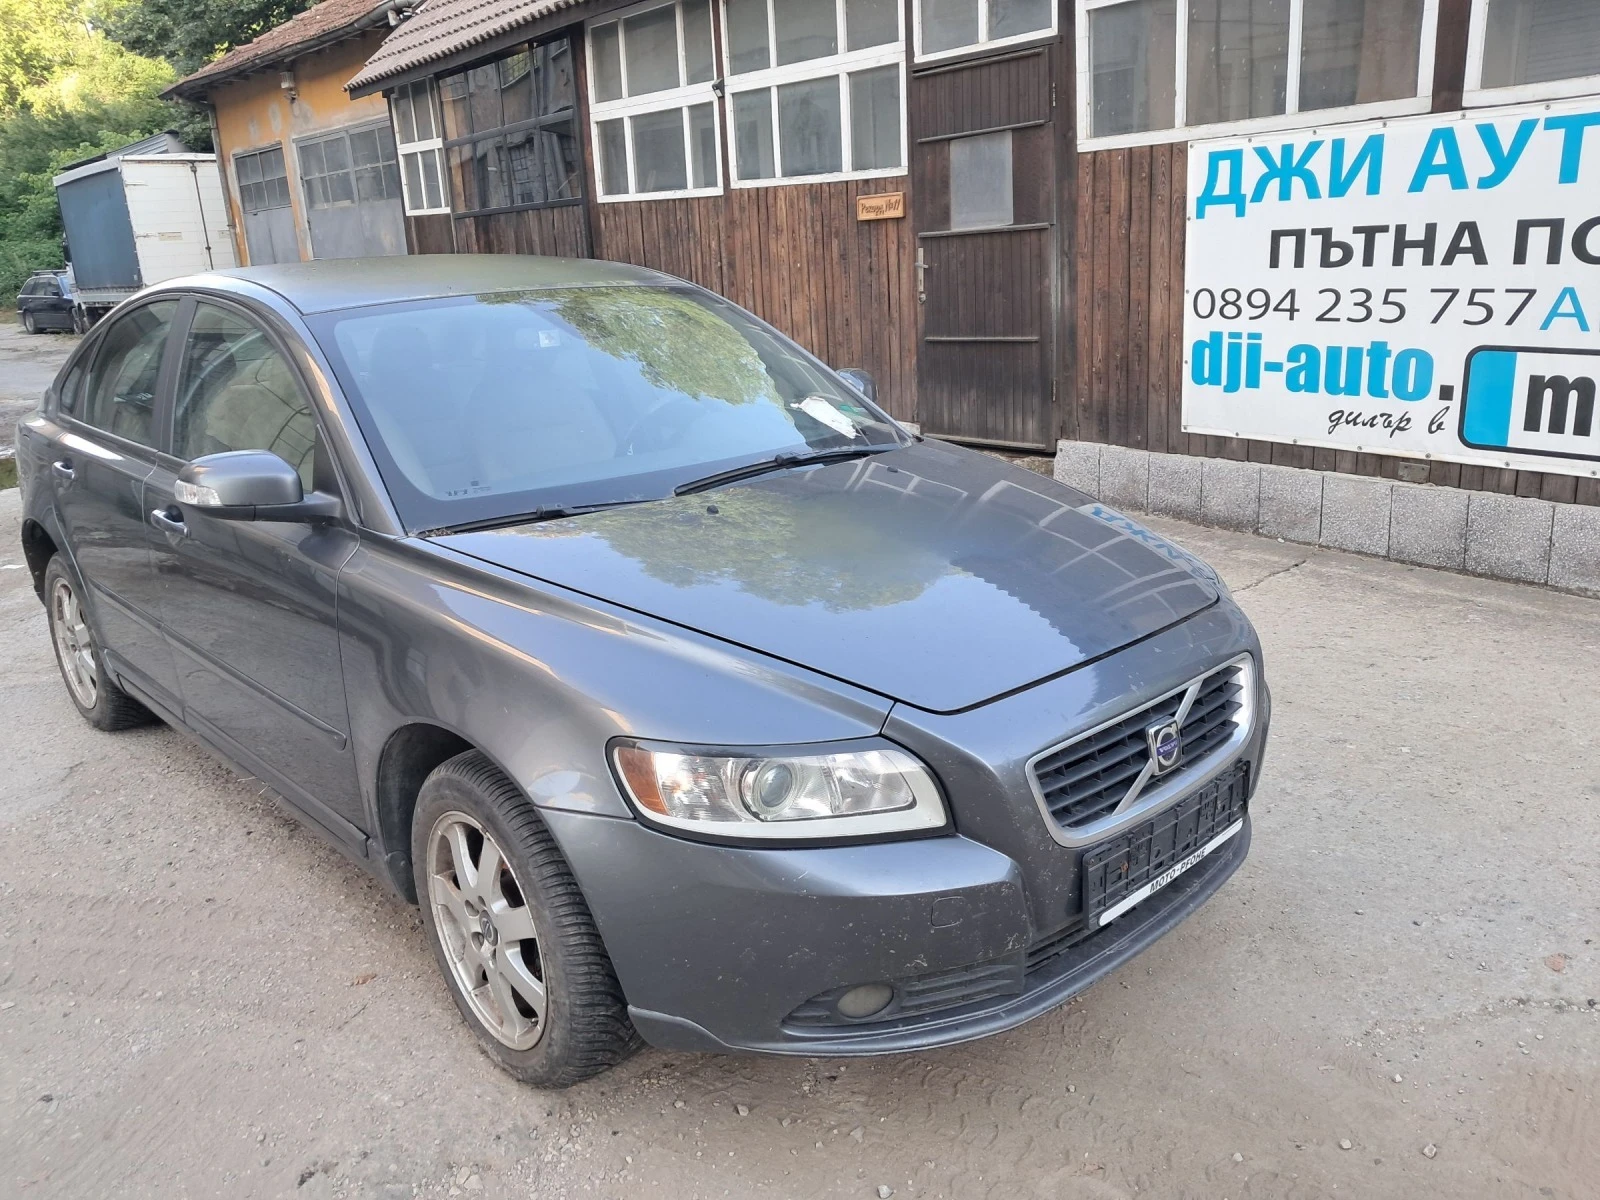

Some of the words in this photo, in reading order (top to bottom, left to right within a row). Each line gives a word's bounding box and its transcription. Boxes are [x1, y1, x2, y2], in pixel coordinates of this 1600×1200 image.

[1196, 134, 1384, 219] ДЖИ
[1408, 112, 1600, 192] АУТ
[1270, 222, 1488, 268] ПЪТНА
[1194, 289, 1299, 320] 0894
[1316, 289, 1406, 323] 235
[1431, 289, 1536, 325] 757
[1192, 331, 1454, 401] dji-auto.
[1328, 409, 1412, 439] дилър
[1427, 405, 1450, 435] в
[1149, 847, 1207, 893] MOTO-PFOHE
